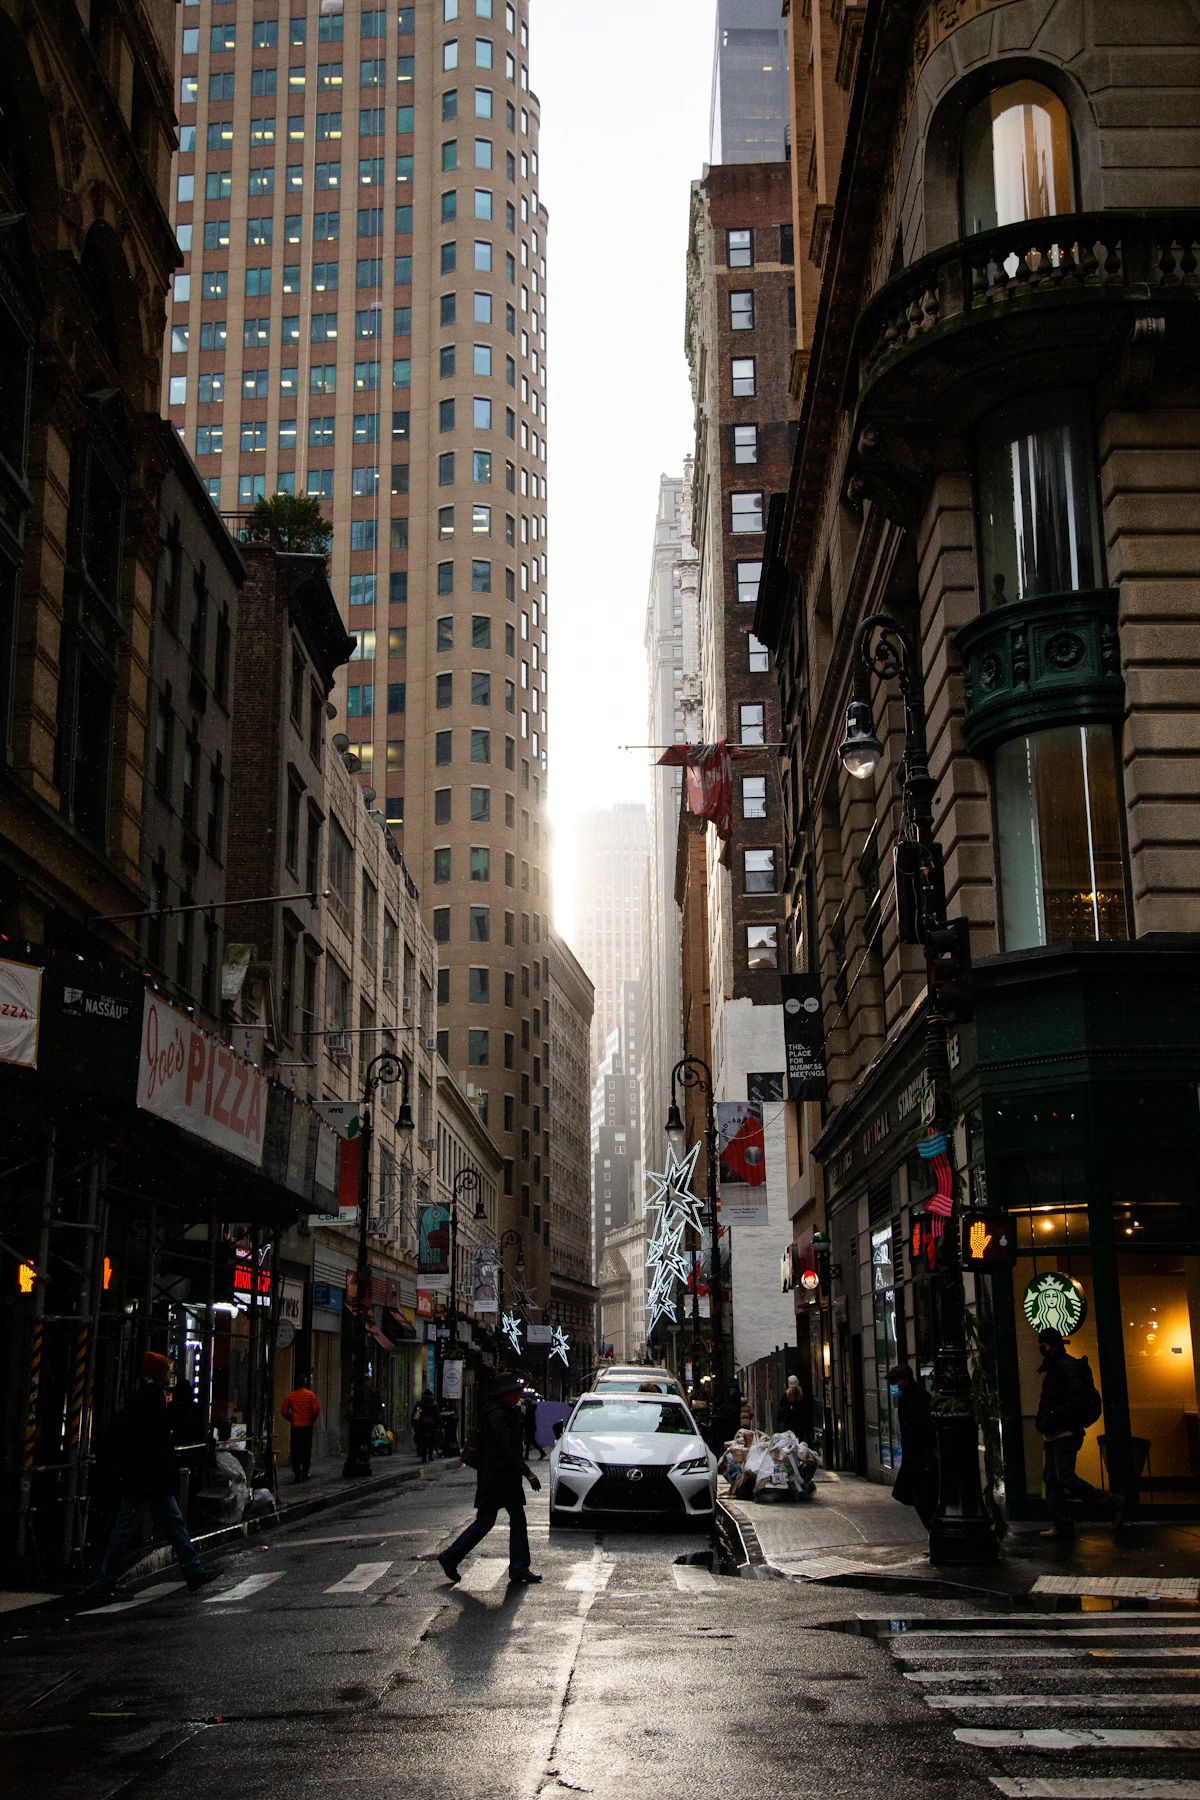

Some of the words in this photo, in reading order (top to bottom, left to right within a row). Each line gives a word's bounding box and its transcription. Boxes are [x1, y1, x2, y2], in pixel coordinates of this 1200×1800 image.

[85, 998, 122, 1019] NASSAU
[122, 1006, 129, 1014] ST
[788, 1043, 802, 1051] THE
[788, 1050, 811, 1058] PLACE
[789, 1057, 804, 1065] FOR
[790, 1063, 823, 1072] BUSINESS
[147, 1004, 184, 1099] Joe's
[185, 1030, 262, 1145] PIZZA
[790, 1070, 826, 1078] MEETINGS
[863, 1110, 890, 1155] OPTICAL
